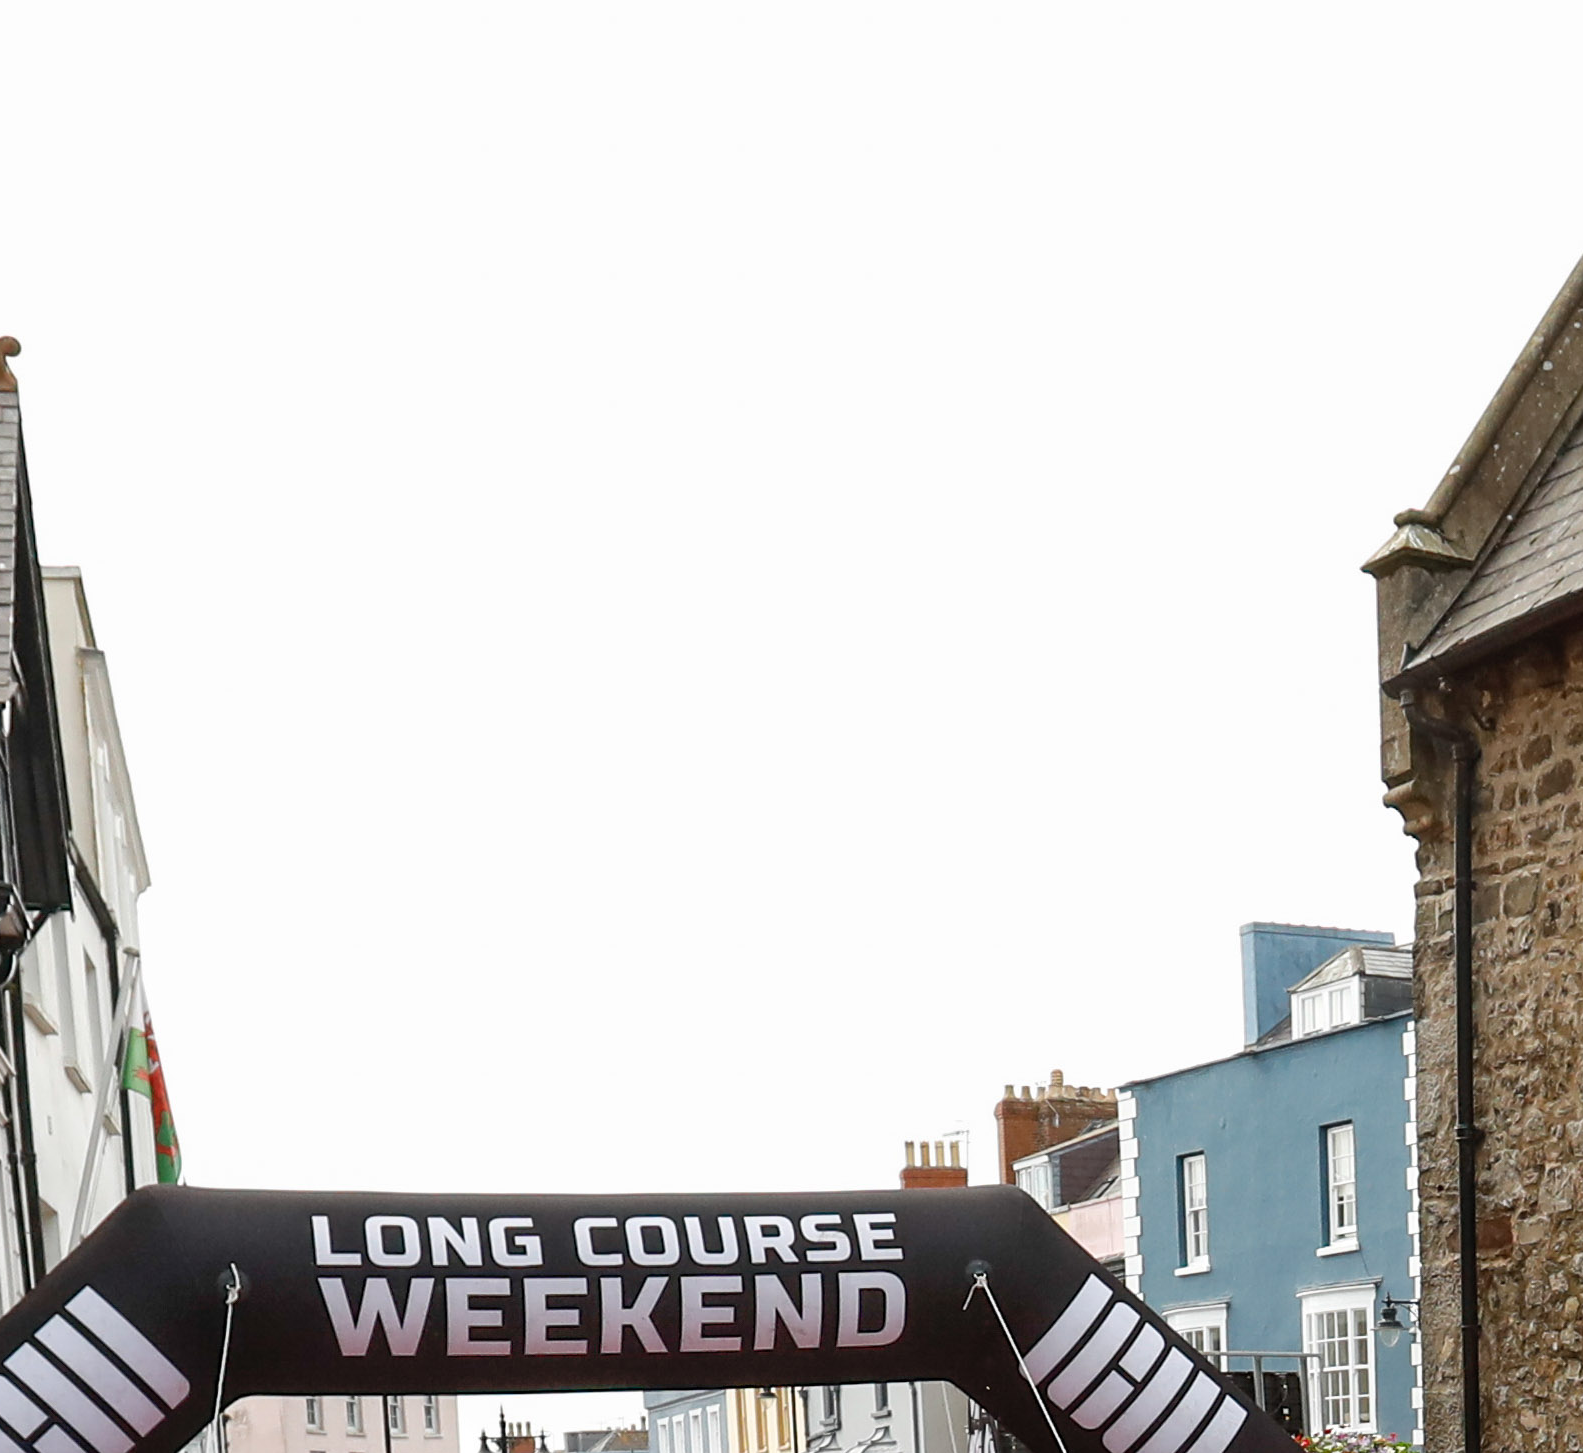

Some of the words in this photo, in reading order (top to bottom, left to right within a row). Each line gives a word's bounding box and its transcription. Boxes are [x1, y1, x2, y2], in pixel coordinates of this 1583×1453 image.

[311, 1214, 544, 1268] LONG
[574, 1211, 906, 1268] COURSE
[317, 1270, 908, 1358] WEEKEND
